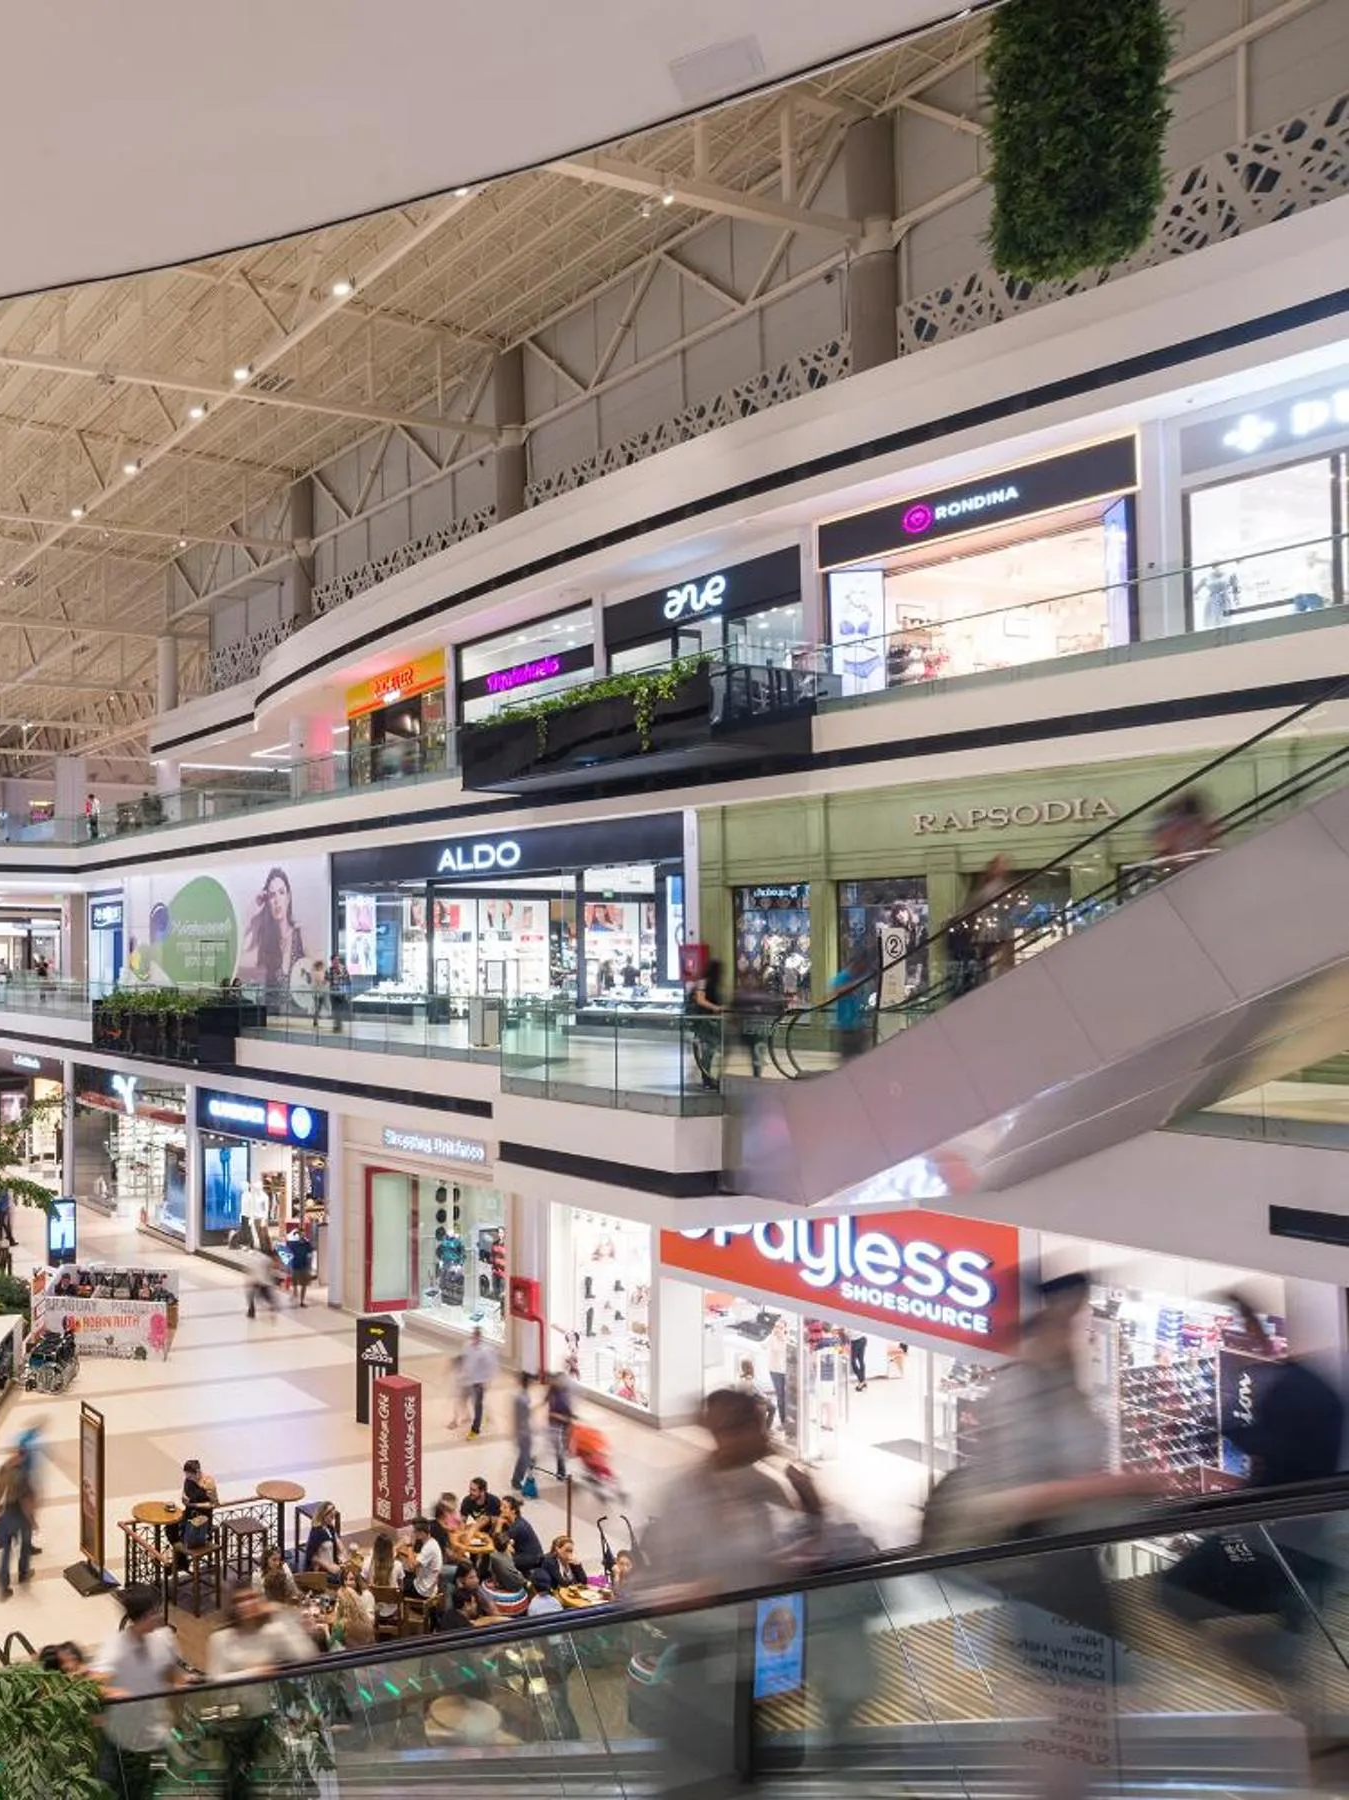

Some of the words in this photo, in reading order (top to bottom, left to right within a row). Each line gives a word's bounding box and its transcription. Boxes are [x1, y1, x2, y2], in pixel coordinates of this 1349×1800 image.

[934, 486, 1020, 520] RONDINA
[913, 797, 1119, 836] RAPSODIA
[437, 841, 522, 872] ALDO
[889, 938, 899, 954] 2
[840, 1281, 991, 1334] SHOESOURCE
[361, 1351, 394, 1364] adidas
